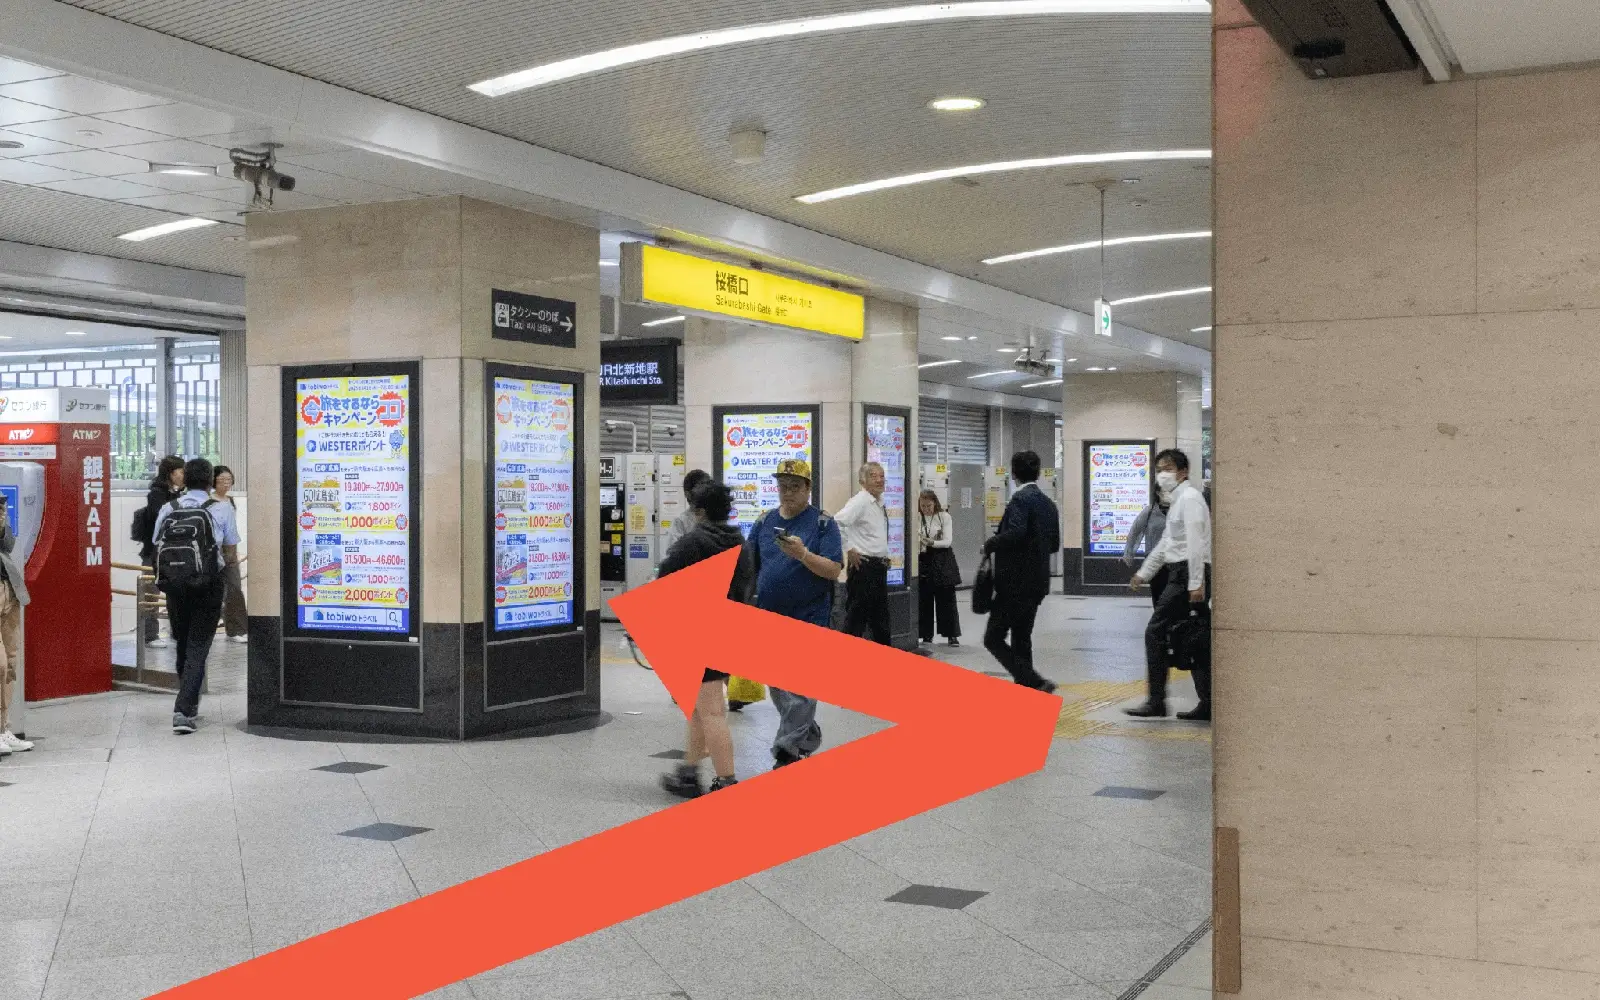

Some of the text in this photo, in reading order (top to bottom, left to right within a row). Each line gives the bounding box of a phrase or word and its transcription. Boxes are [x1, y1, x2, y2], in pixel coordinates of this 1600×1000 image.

[716, 271, 749, 296] 桜橋口
[716, 295, 772, 315] Sakurabashi Gate
[510, 305, 560, 323] タクシーのりば
[510, 318, 524, 330] Taxi
[600, 362, 660, 376] JR北新地駅
[606, 376, 648, 386] Kitashinchi
[11, 400, 47, 411] セブン銀行
[79, 402, 107, 411] セブン銀行
[320, 394, 380, 411] 旅をするなら
[324, 411, 377, 427] キャンペーン
[9, 429, 29, 440] ATM
[73, 430, 94, 440] ATM
[319, 440, 387, 452] WESTERポイント
[745, 438, 786, 448] キャンペーン
[83, 455, 103, 566] 銀行ATM
